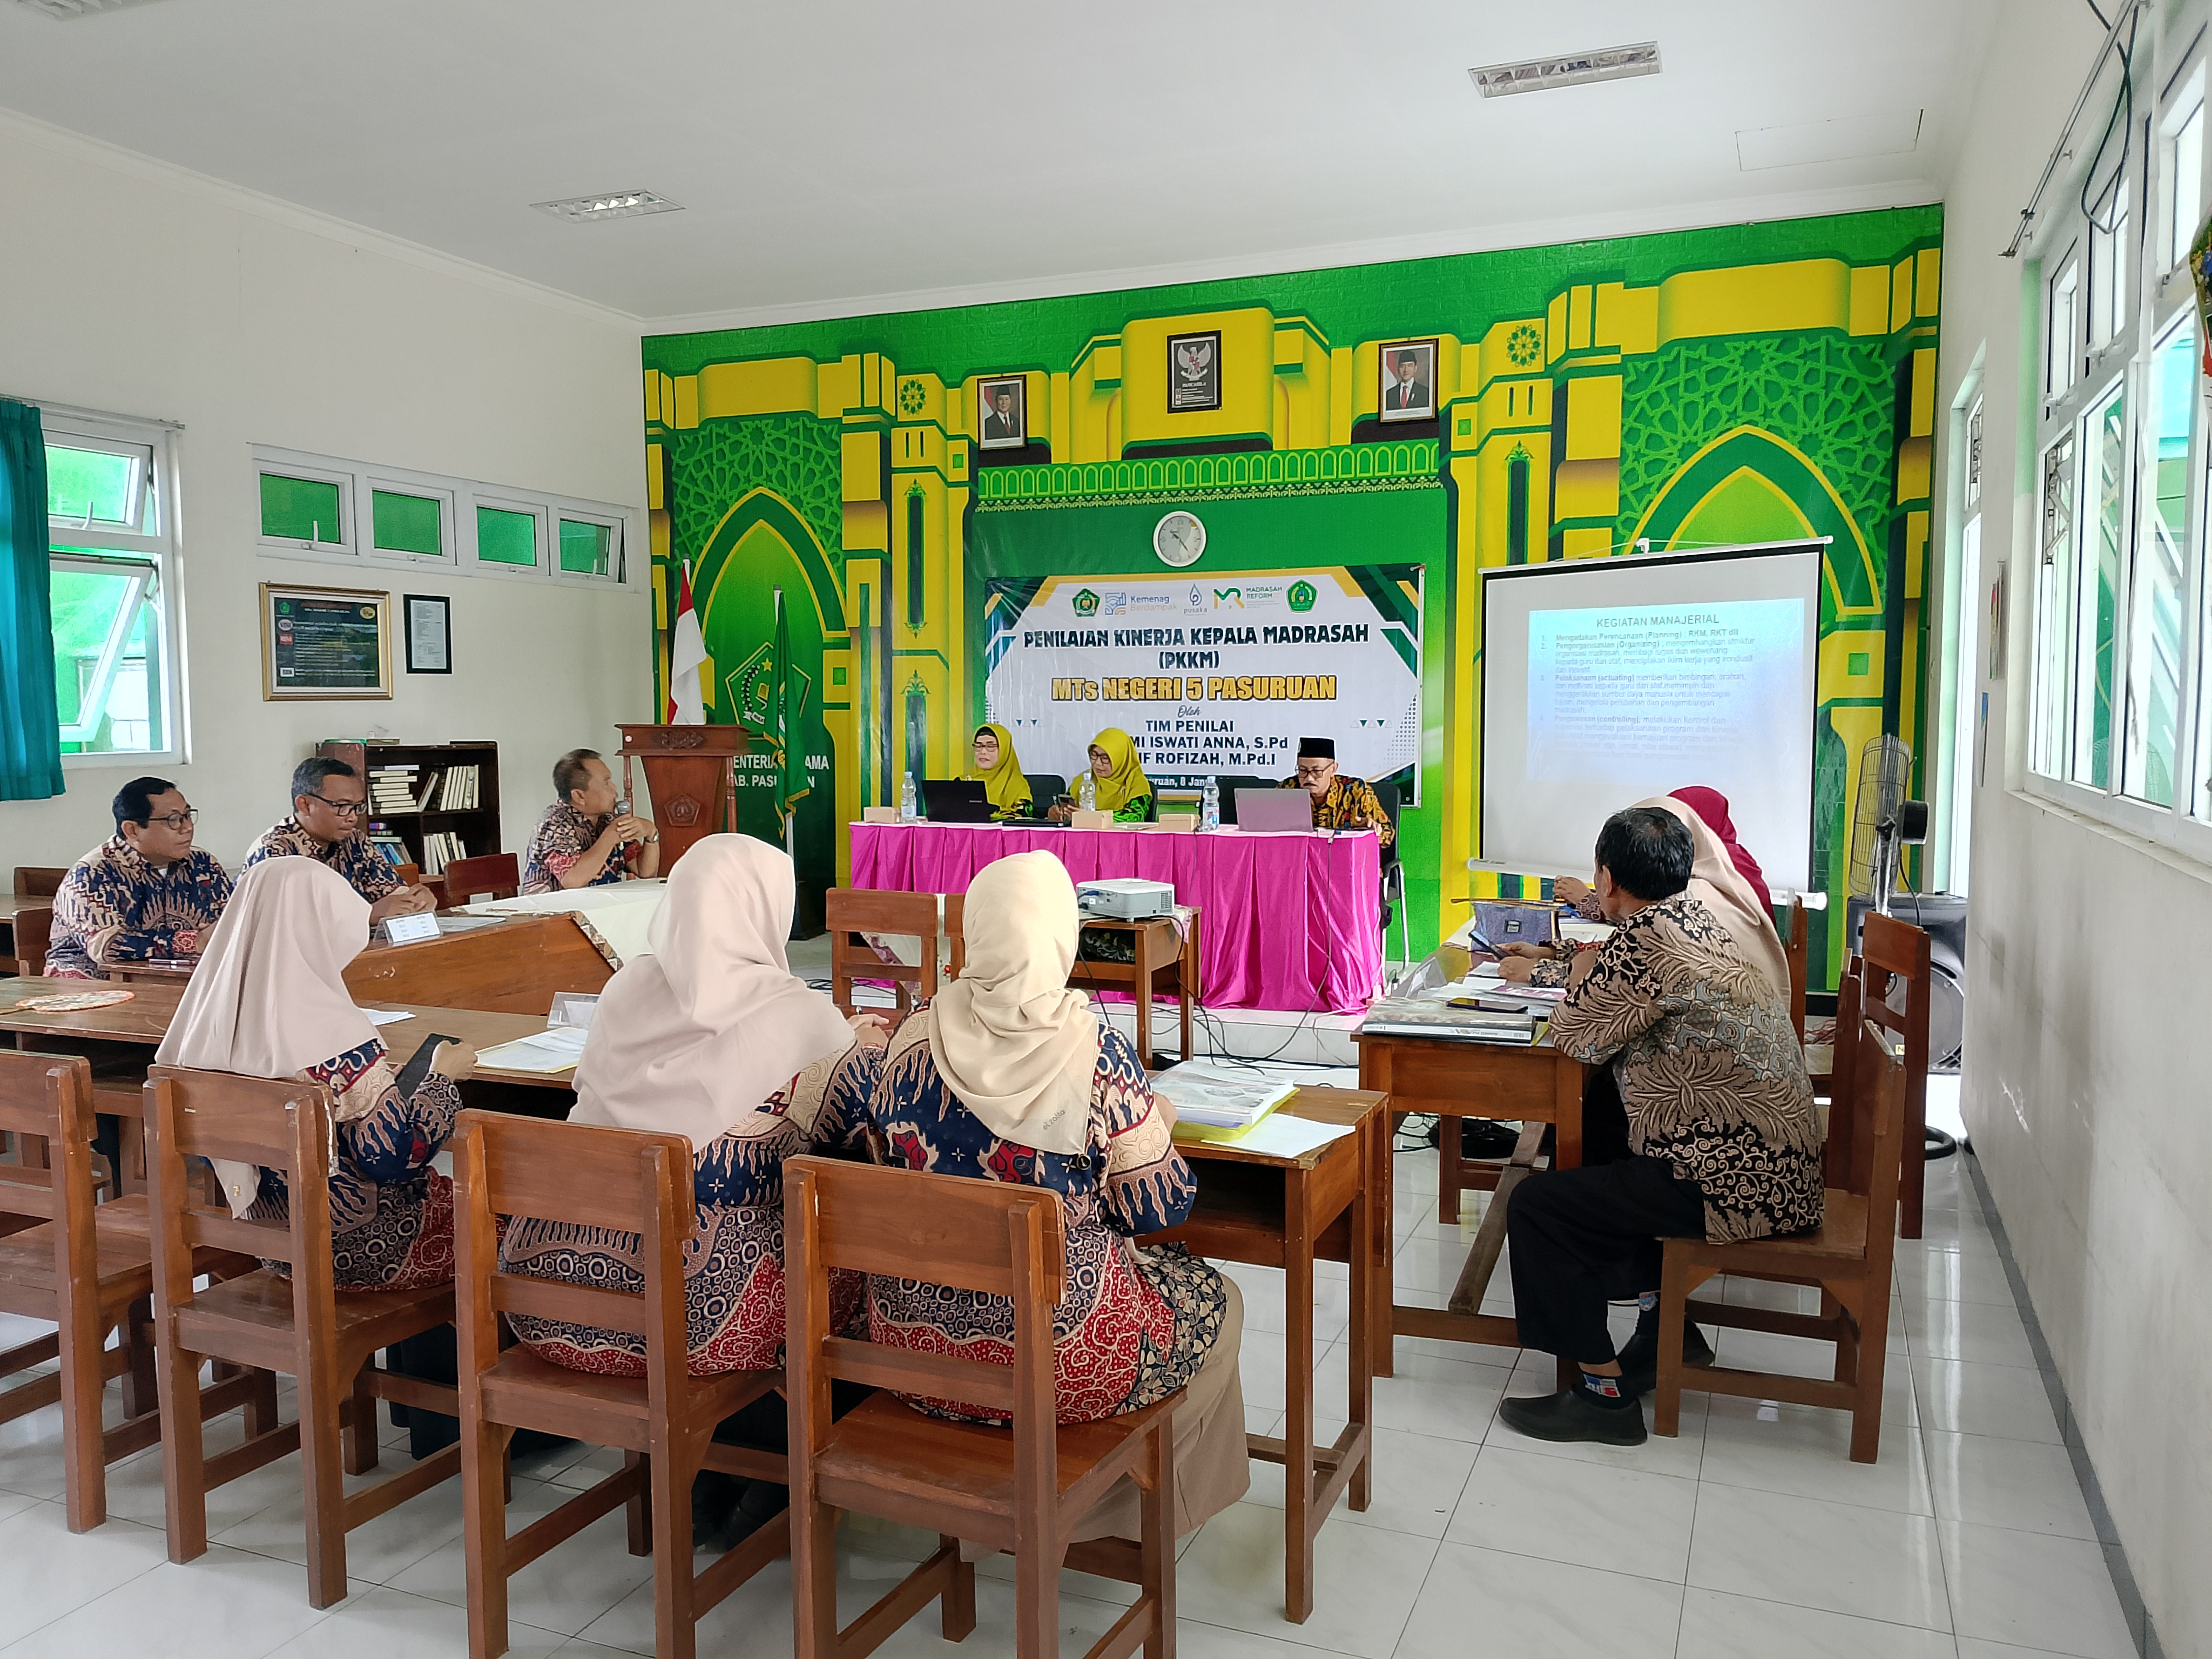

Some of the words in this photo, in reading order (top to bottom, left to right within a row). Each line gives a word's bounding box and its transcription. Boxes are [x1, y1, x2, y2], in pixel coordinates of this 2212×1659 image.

[1130, 603, 1177, 611] Berdampak
[1131, 596, 1170, 604] Kemenag
[1597, 617, 1647, 628] KEGIATAN
[1650, 614, 1719, 625] MANAJERIAL
[1024, 630, 1109, 648] PENILAIAN
[1114, 629, 1185, 646] KINERJA
[1190, 626, 1258, 645] KEPALA
[1263, 624, 1369, 644] MADRASAH
[1645, 631, 1682, 641] (Planning)
[1159, 650, 1219, 669] (PKKM)
[1051, 677, 1098, 702] MTs
[1102, 677, 1182, 702] NEGERI
[1186, 676, 1203, 701] 5
[1208, 675, 1337, 700] PASURUAN
[1145, 720, 1170, 732] TIM
[1175, 720, 1234, 732] PENILAI
[1131, 736, 1145, 748] MI
[1150, 736, 1198, 748] ISWATI
[1203, 736, 1250, 751] ANNA,
[1254, 736, 1289, 749] S.Pd
[733, 754, 776, 769] ENTERI
[805, 754, 830, 770] AMA
[1155, 752, 1224, 767] ROFIZAH,
[1229, 753, 1276, 765] M.Pd.I
[1188, 777, 1208, 786] Jan
